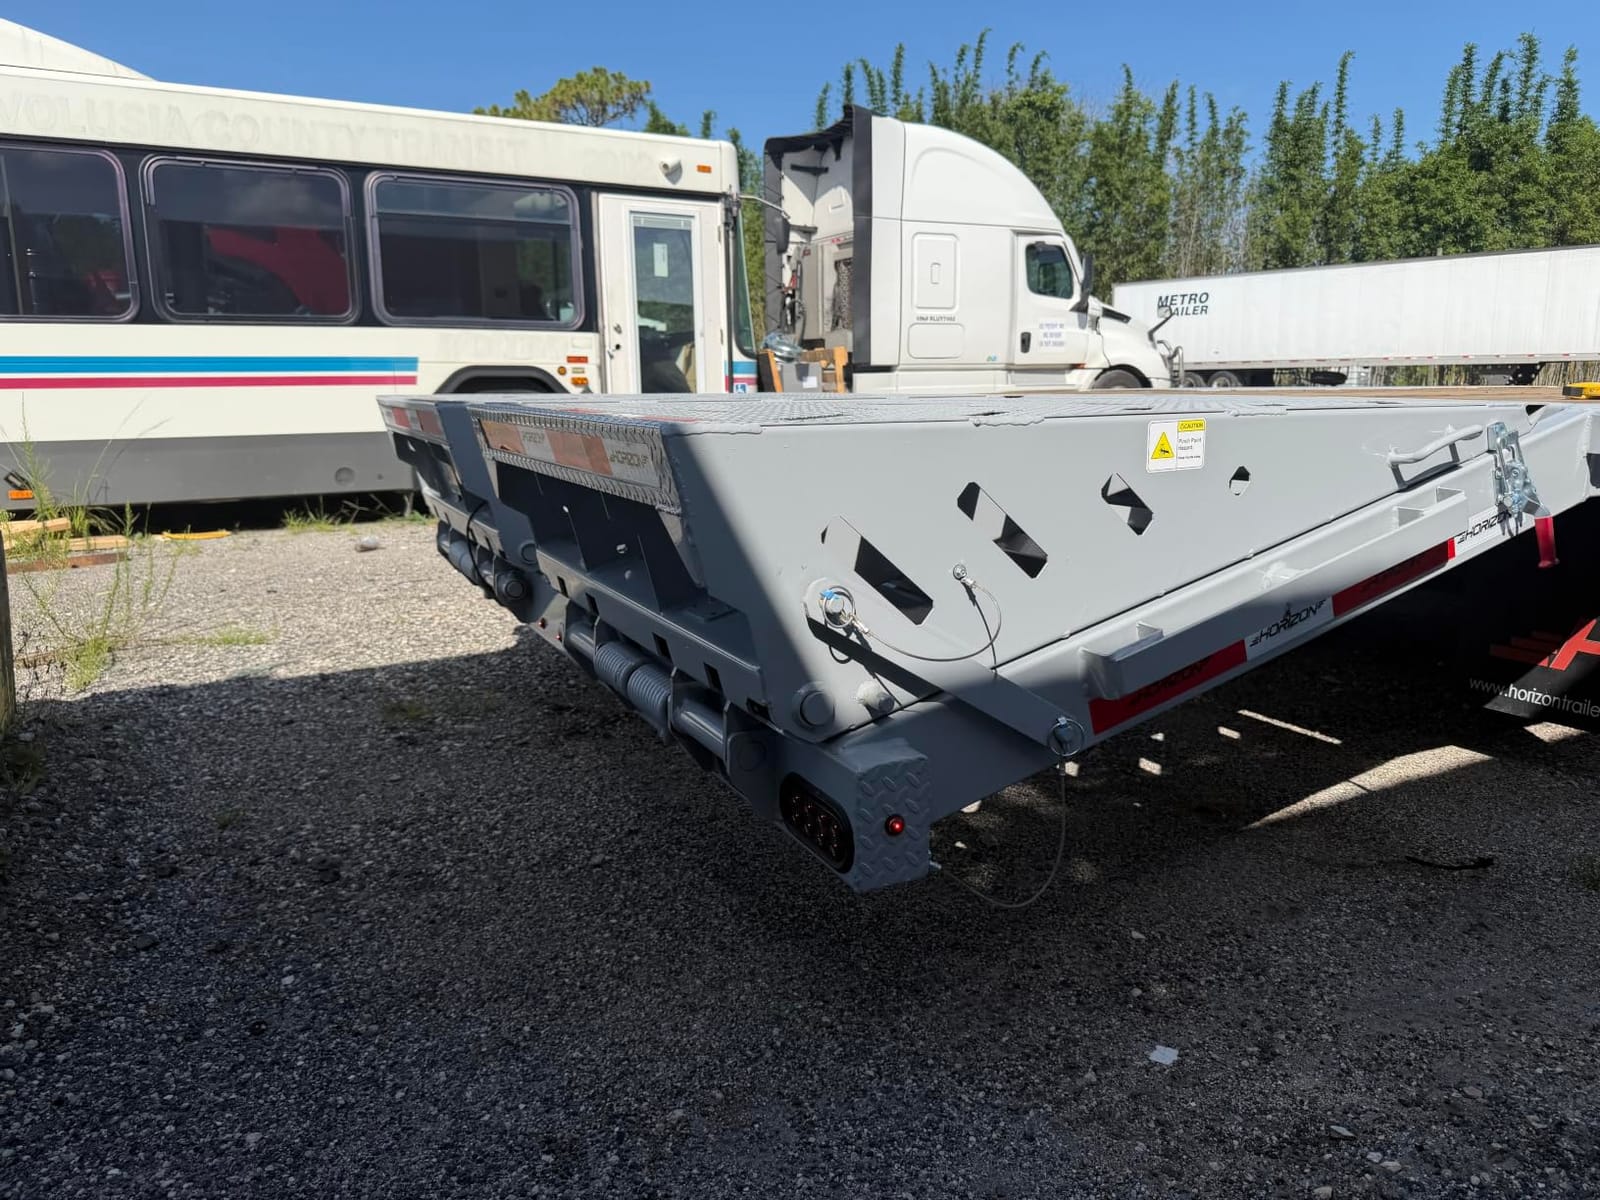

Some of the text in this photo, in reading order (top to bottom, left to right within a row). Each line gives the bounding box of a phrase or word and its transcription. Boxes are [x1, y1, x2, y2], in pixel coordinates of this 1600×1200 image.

[1158, 292, 1209, 307] METRO
[1169, 305, 1208, 316] AILER
[1257, 605, 1318, 643] HORIZON
